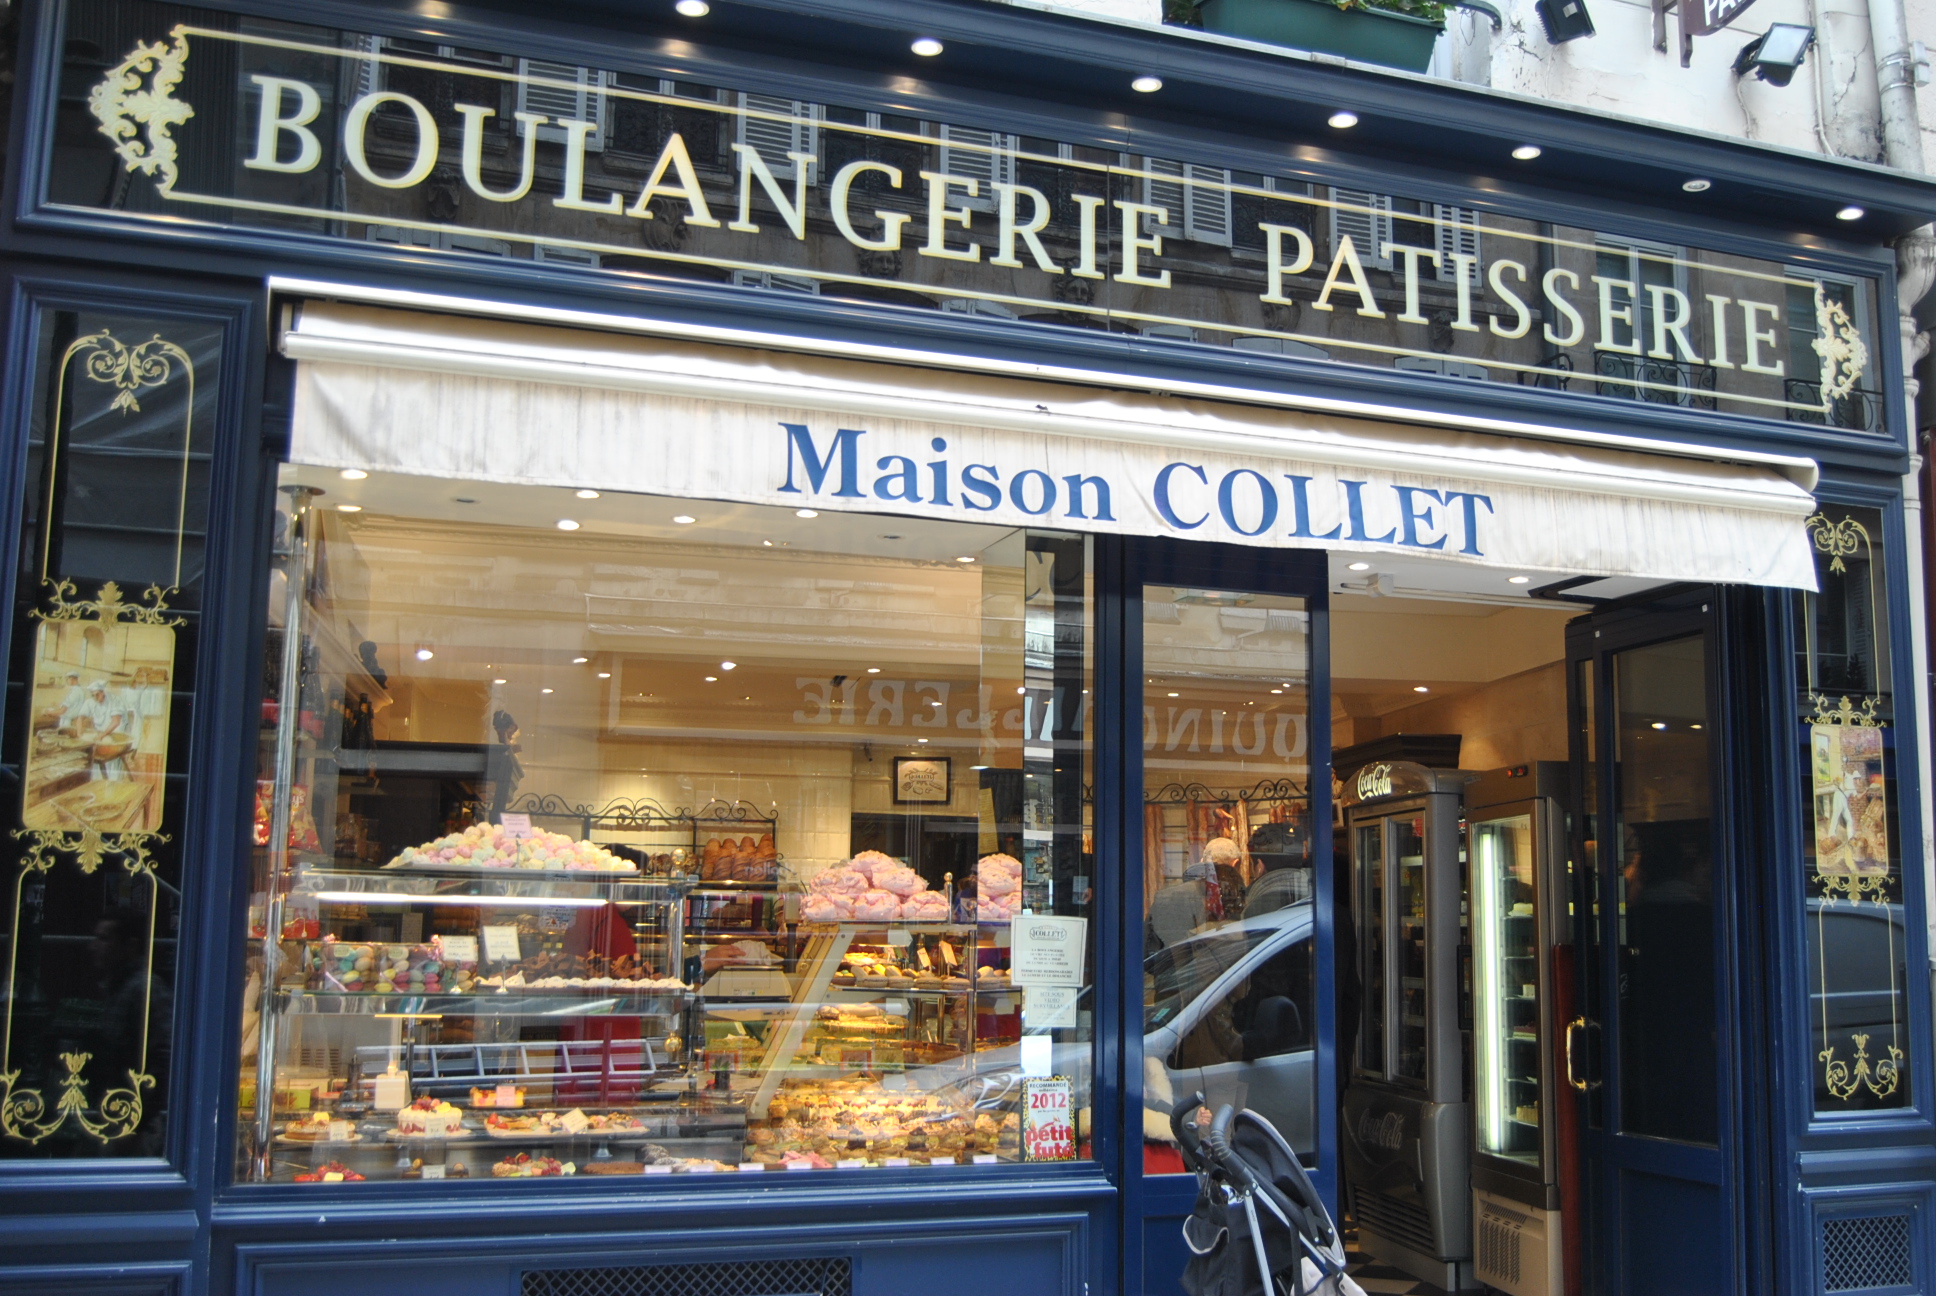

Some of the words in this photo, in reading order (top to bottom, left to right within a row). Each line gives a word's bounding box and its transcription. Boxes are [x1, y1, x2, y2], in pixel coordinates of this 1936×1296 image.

[243, 75, 1171, 288] BOULANGERIE
[1258, 223, 1785, 376] PATISSERIE
[777, 422, 1116, 521] Maison
[1153, 462, 1491, 567] COLLET
[1025, 1124, 1075, 1146] petit
[1031, 1093, 1067, 1109] 2012
